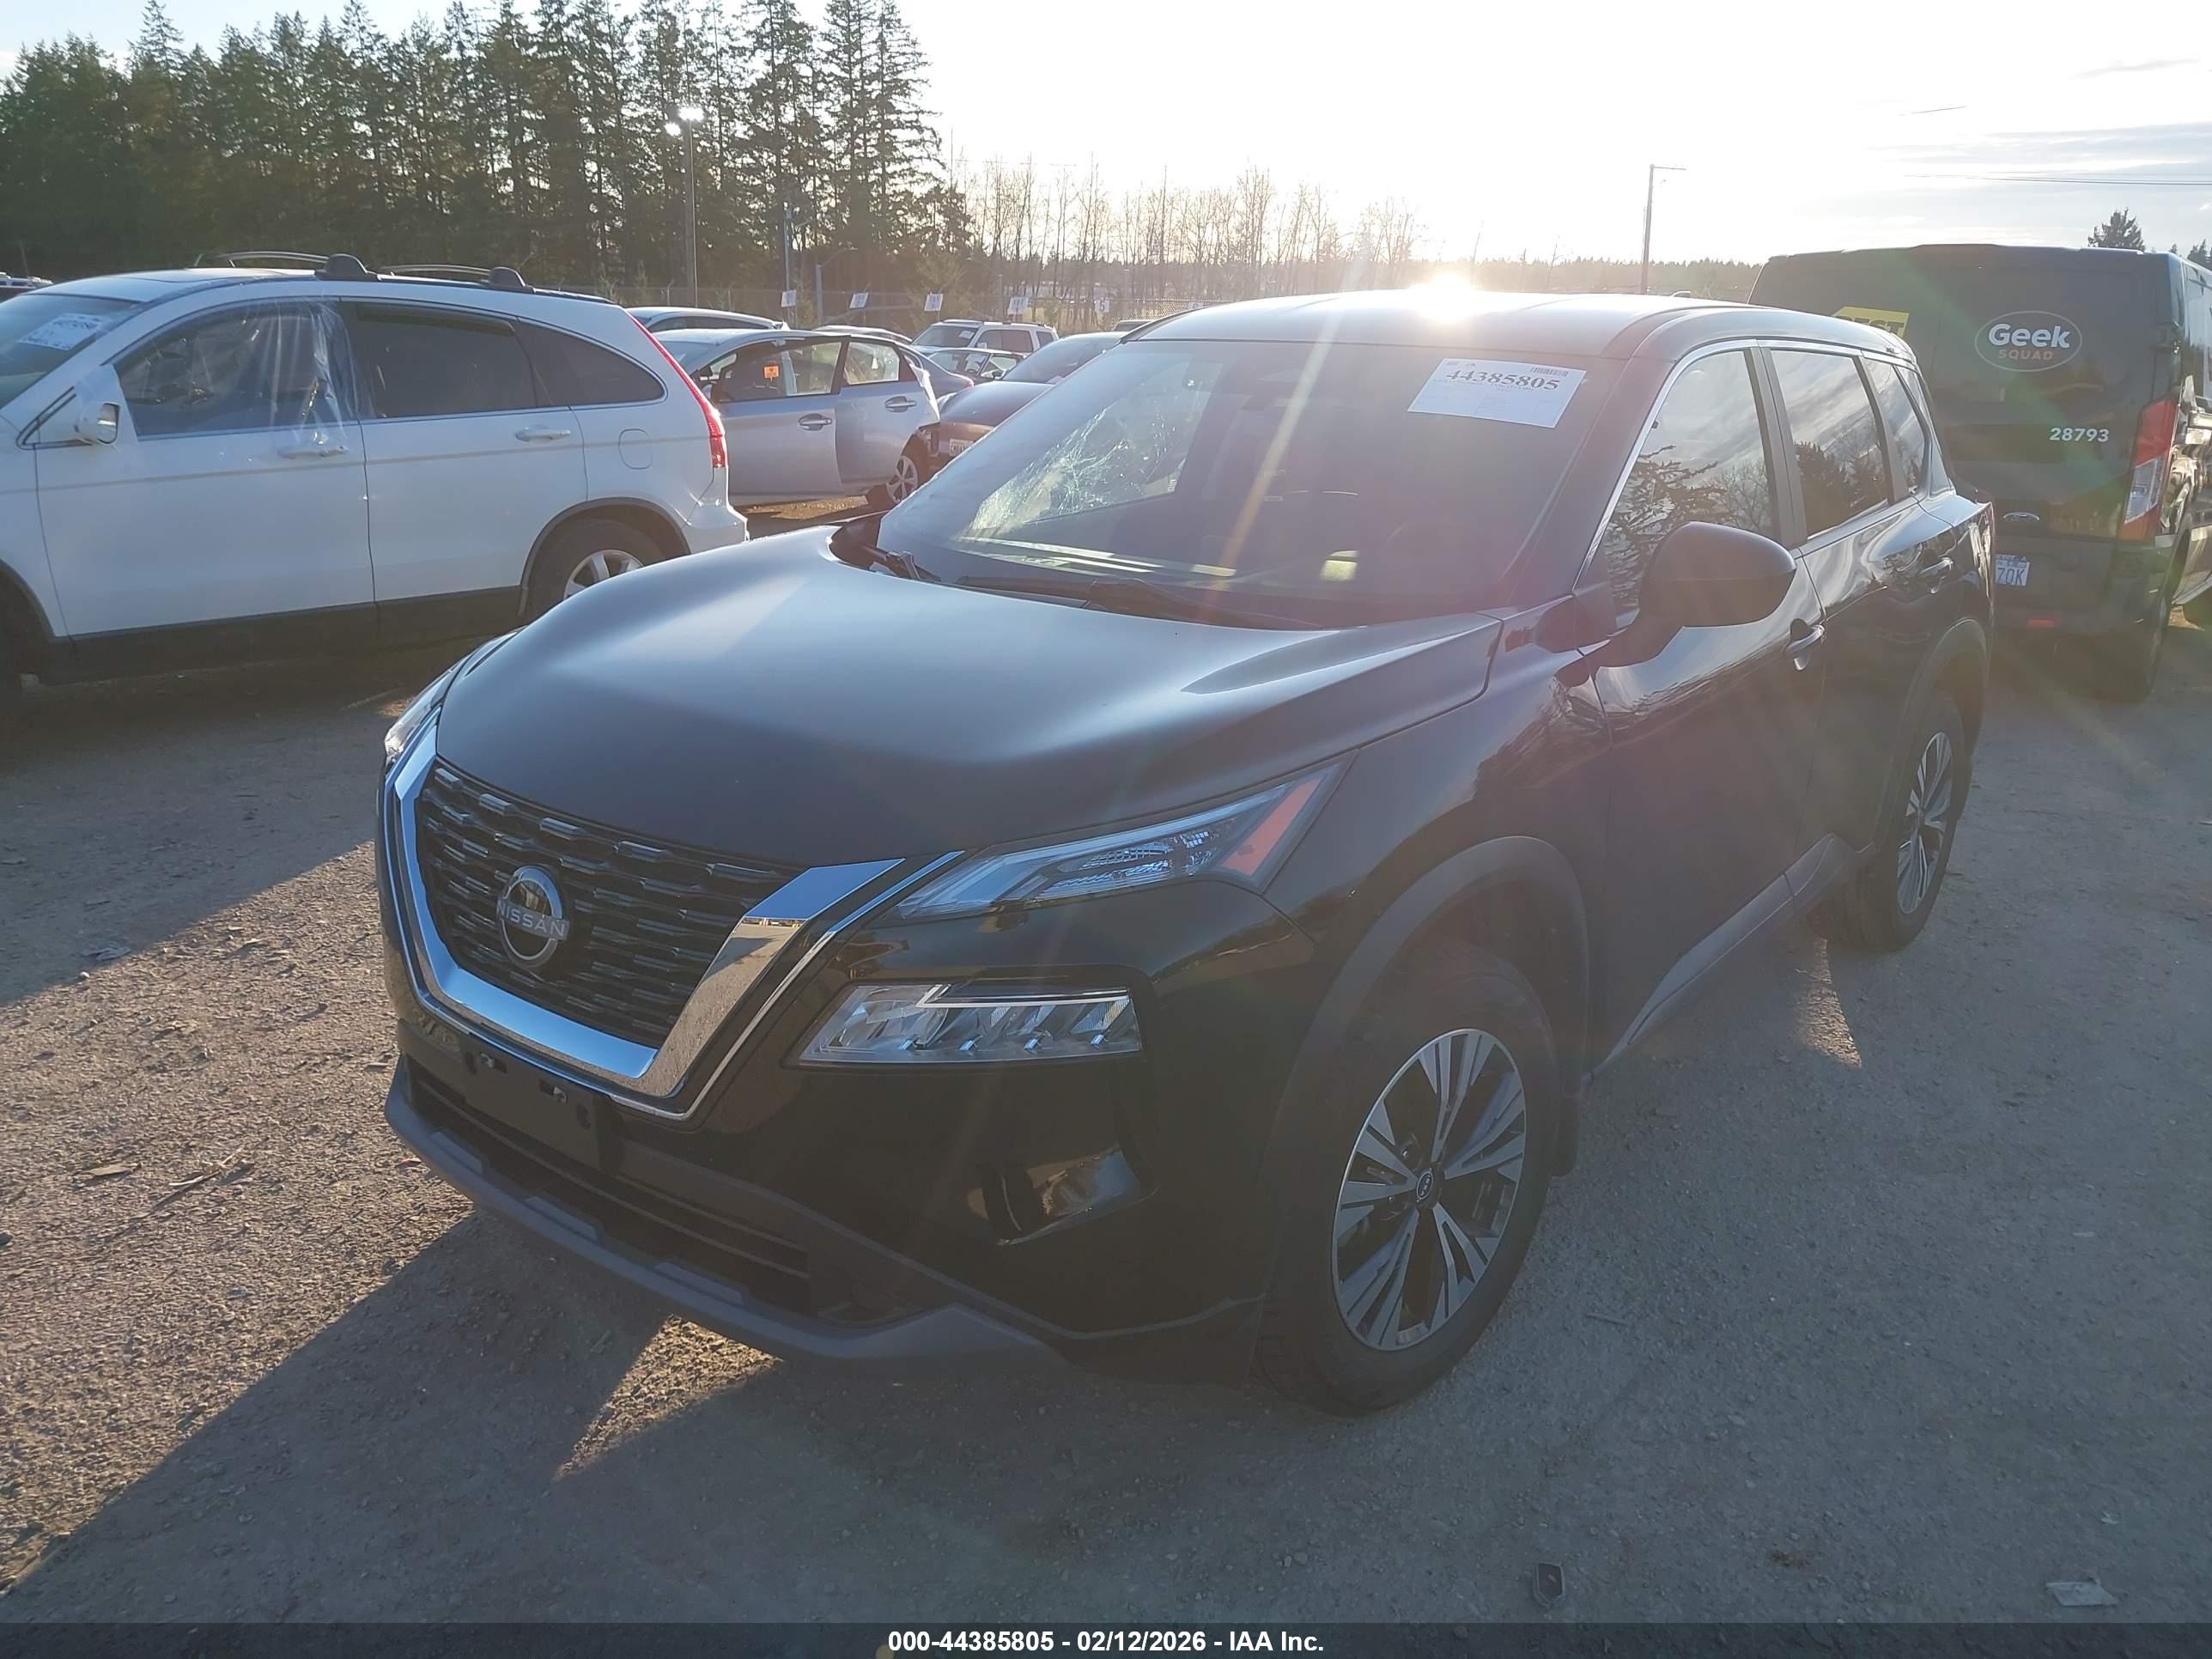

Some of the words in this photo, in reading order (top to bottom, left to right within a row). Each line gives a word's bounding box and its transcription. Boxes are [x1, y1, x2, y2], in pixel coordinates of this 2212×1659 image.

[1989, 323, 2070, 349] Geek
[1998, 349, 2054, 361] SQUAD
[1446, 370, 1560, 391] 44385805
[2049, 427, 2110, 442] 28793
[496, 899, 565, 937] NISSAN
